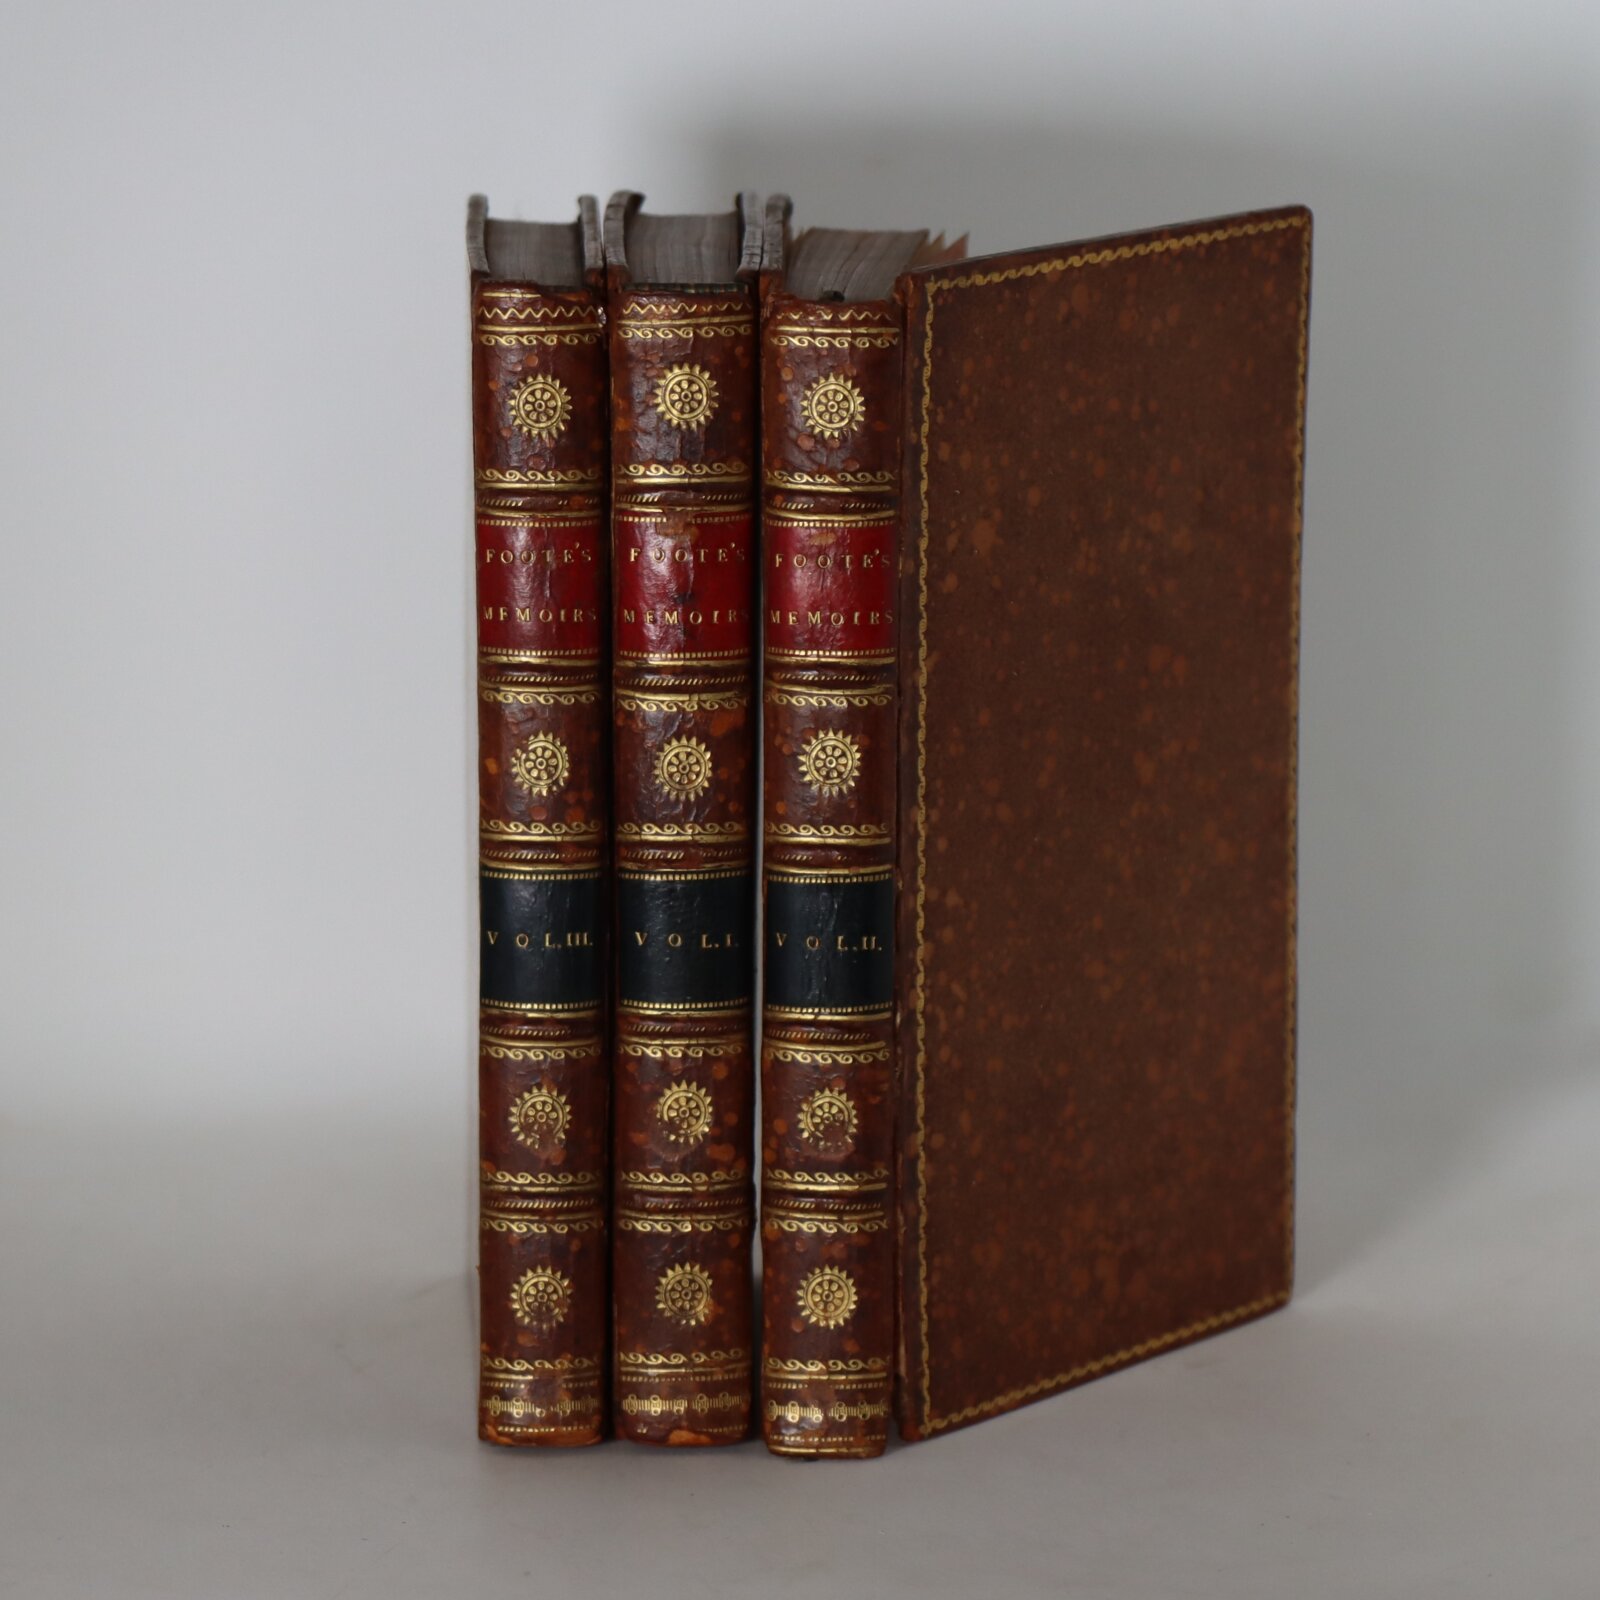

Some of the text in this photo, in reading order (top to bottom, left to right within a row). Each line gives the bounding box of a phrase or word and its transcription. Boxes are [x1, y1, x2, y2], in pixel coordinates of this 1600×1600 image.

[486, 541, 592, 563] FOOTE'S
[775, 548, 891, 568] FOOTE'S
[483, 606, 597, 623] MEMOIRS
[624, 608, 748, 625] MEMOIR
[770, 609, 894, 626] MEMOIRS
